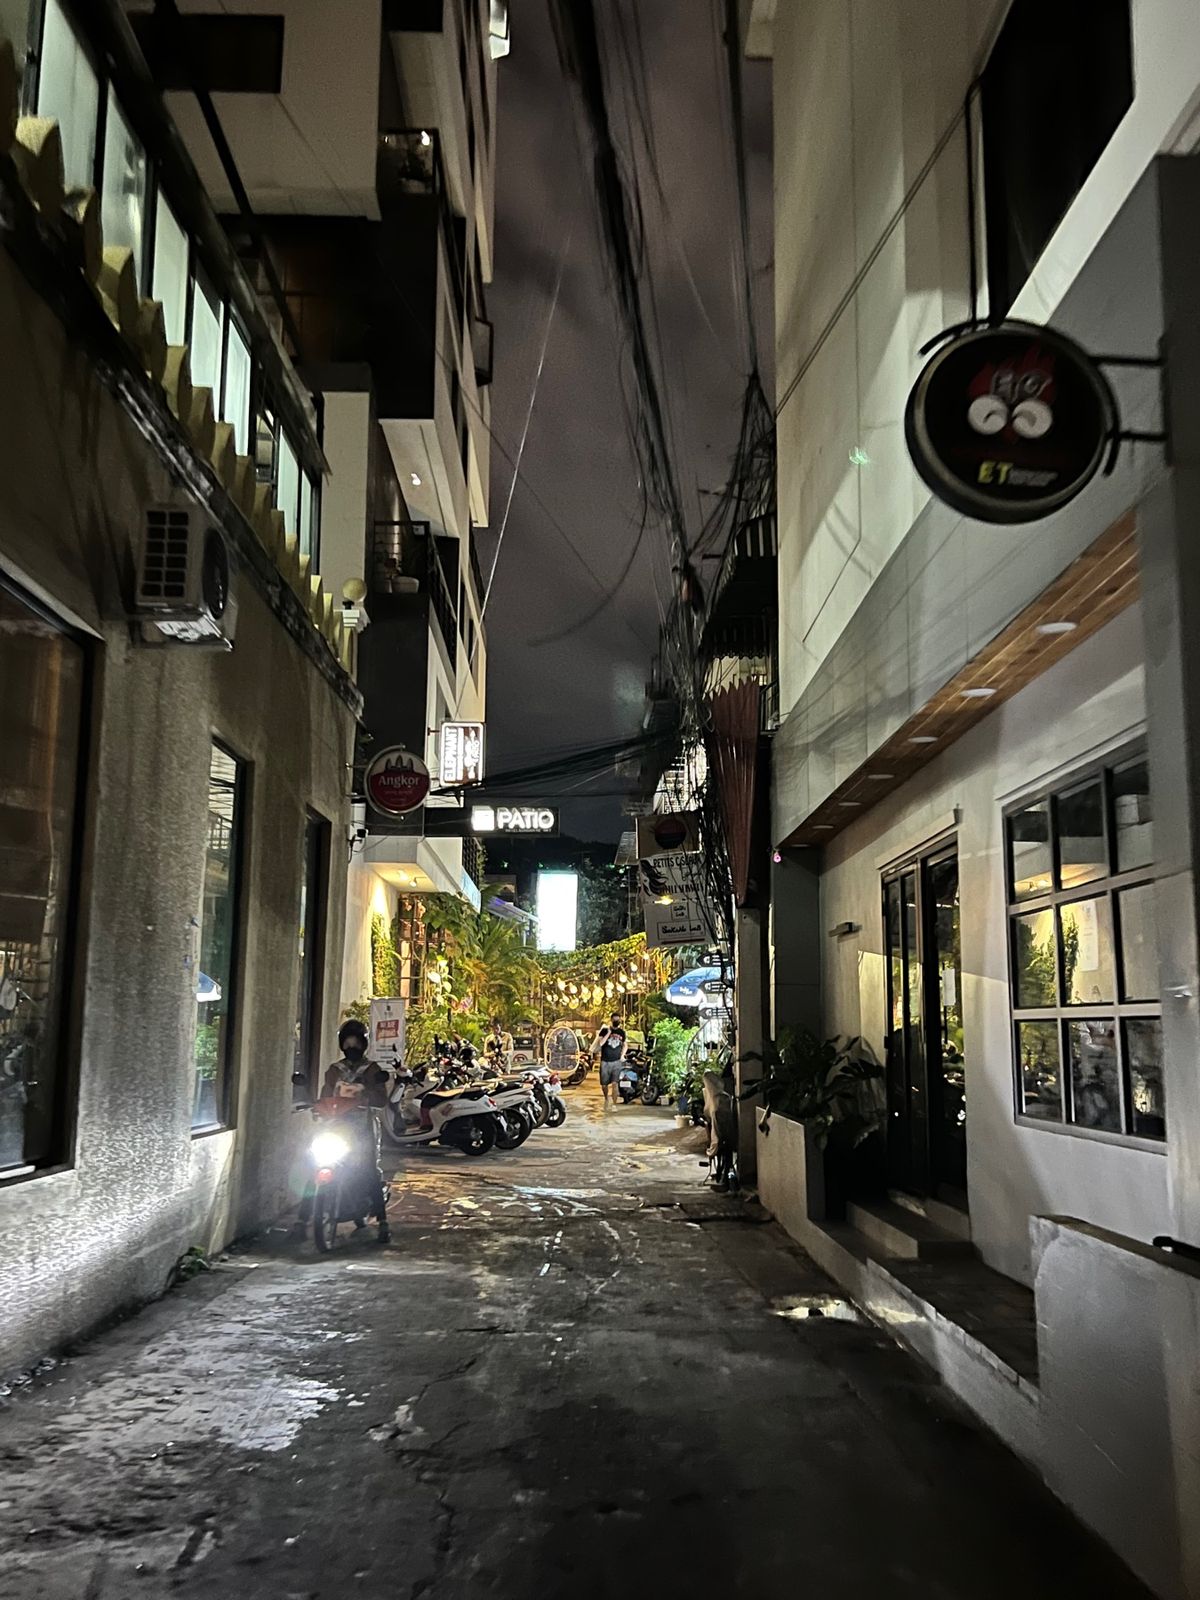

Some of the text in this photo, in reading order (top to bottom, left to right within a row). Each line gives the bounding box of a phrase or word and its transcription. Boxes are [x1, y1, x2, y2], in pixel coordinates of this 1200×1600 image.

[445, 726, 458, 782] ELEPHANT
[377, 774, 420, 788] Angkor
[496, 807, 555, 830] PATIO
[653, 857, 675, 868] PETITS
